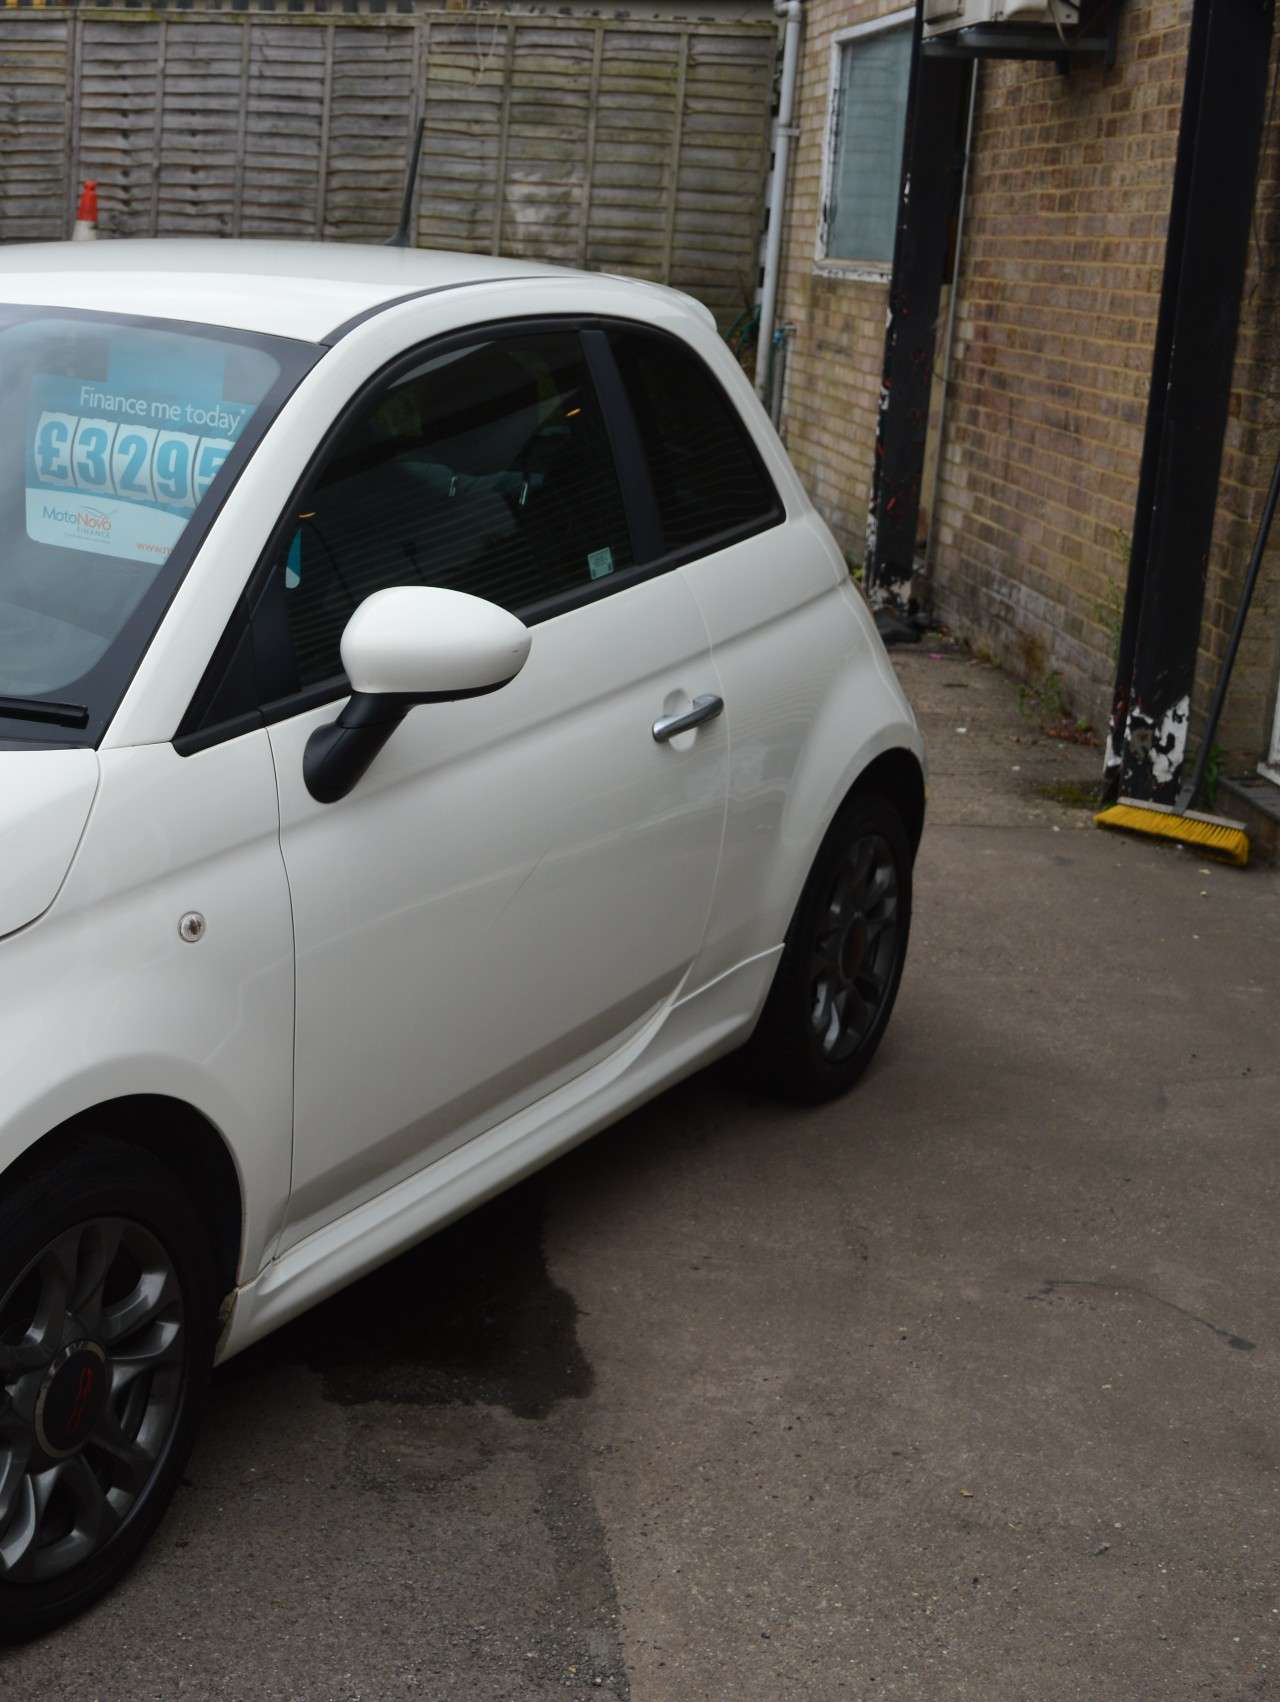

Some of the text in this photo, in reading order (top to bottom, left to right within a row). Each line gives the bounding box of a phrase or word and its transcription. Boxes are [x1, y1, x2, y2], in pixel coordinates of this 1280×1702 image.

[80, 386, 147, 415] Finance
[151, 401, 181, 421] me
[42, 505, 112, 531] MotoNovo
